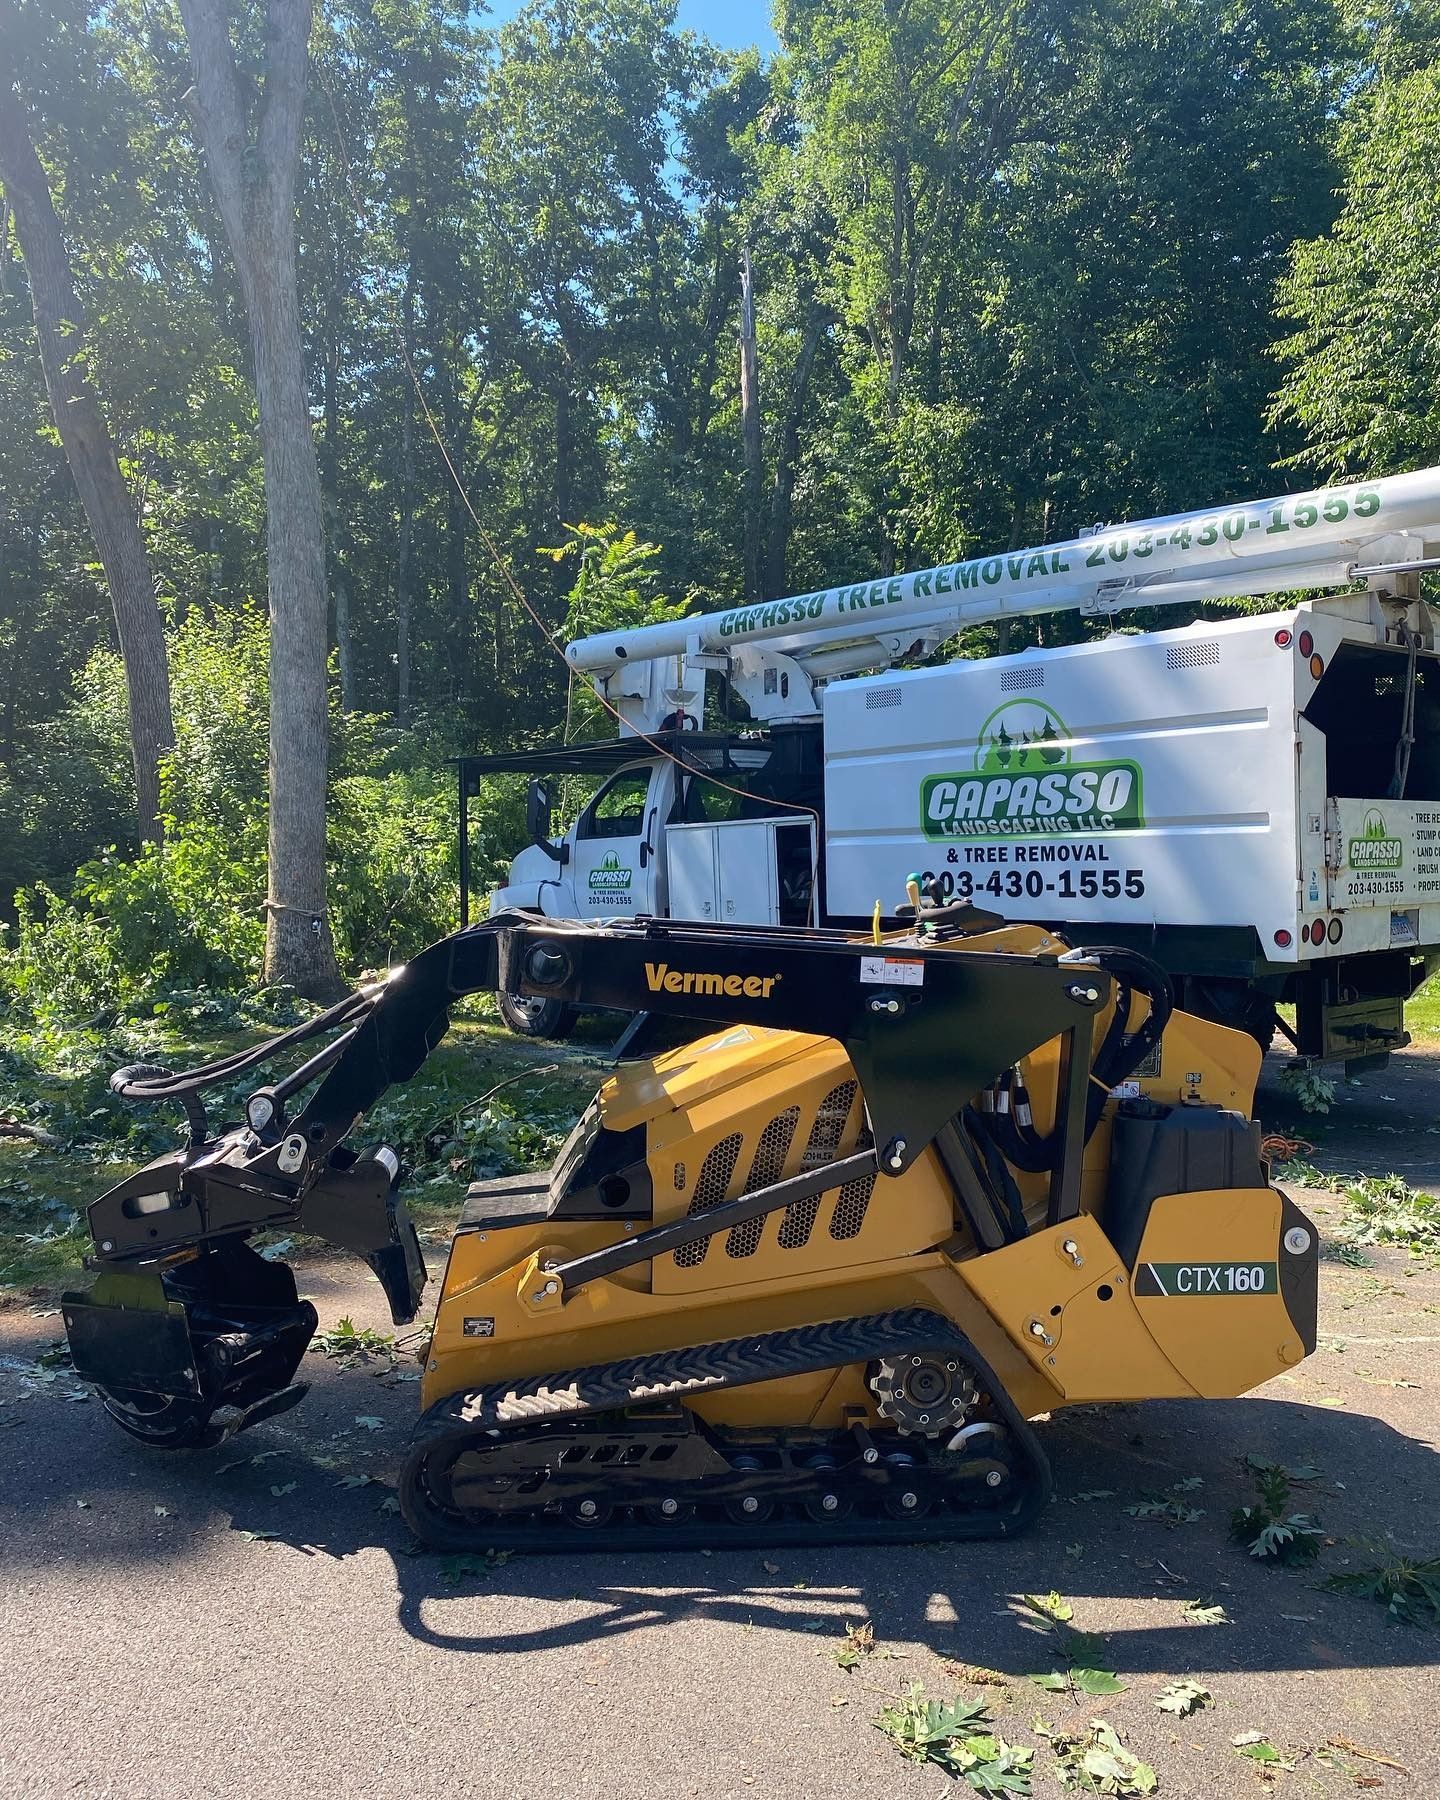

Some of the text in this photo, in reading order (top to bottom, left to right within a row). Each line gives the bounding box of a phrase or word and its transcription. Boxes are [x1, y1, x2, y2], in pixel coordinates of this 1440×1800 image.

[719, 484, 1381, 636] CAPASSO TREE REMOVAL 203-430-1555
[928, 769, 1133, 820] CAPASSO
[1416, 813, 1430, 823] TREE
[941, 814, 1116, 836] LANDSCAPING LLC
[1416, 830, 1436, 840] STUMP
[947, 845, 1109, 863] & TREE REMOVAL
[1351, 841, 1400, 859] CAPASSO
[1417, 847, 1433, 857] LAND
[1389, 858, 1397, 866] LLC
[1418, 864, 1439, 874] BRUSH
[590, 871, 630, 882] CAPASSO
[1374, 871, 1396, 879] REMOVAL
[921, 870, 1145, 899] 203-430-1555
[1418, 880, 1440, 891] PROPE
[644, 962, 776, 998] Vermeer
